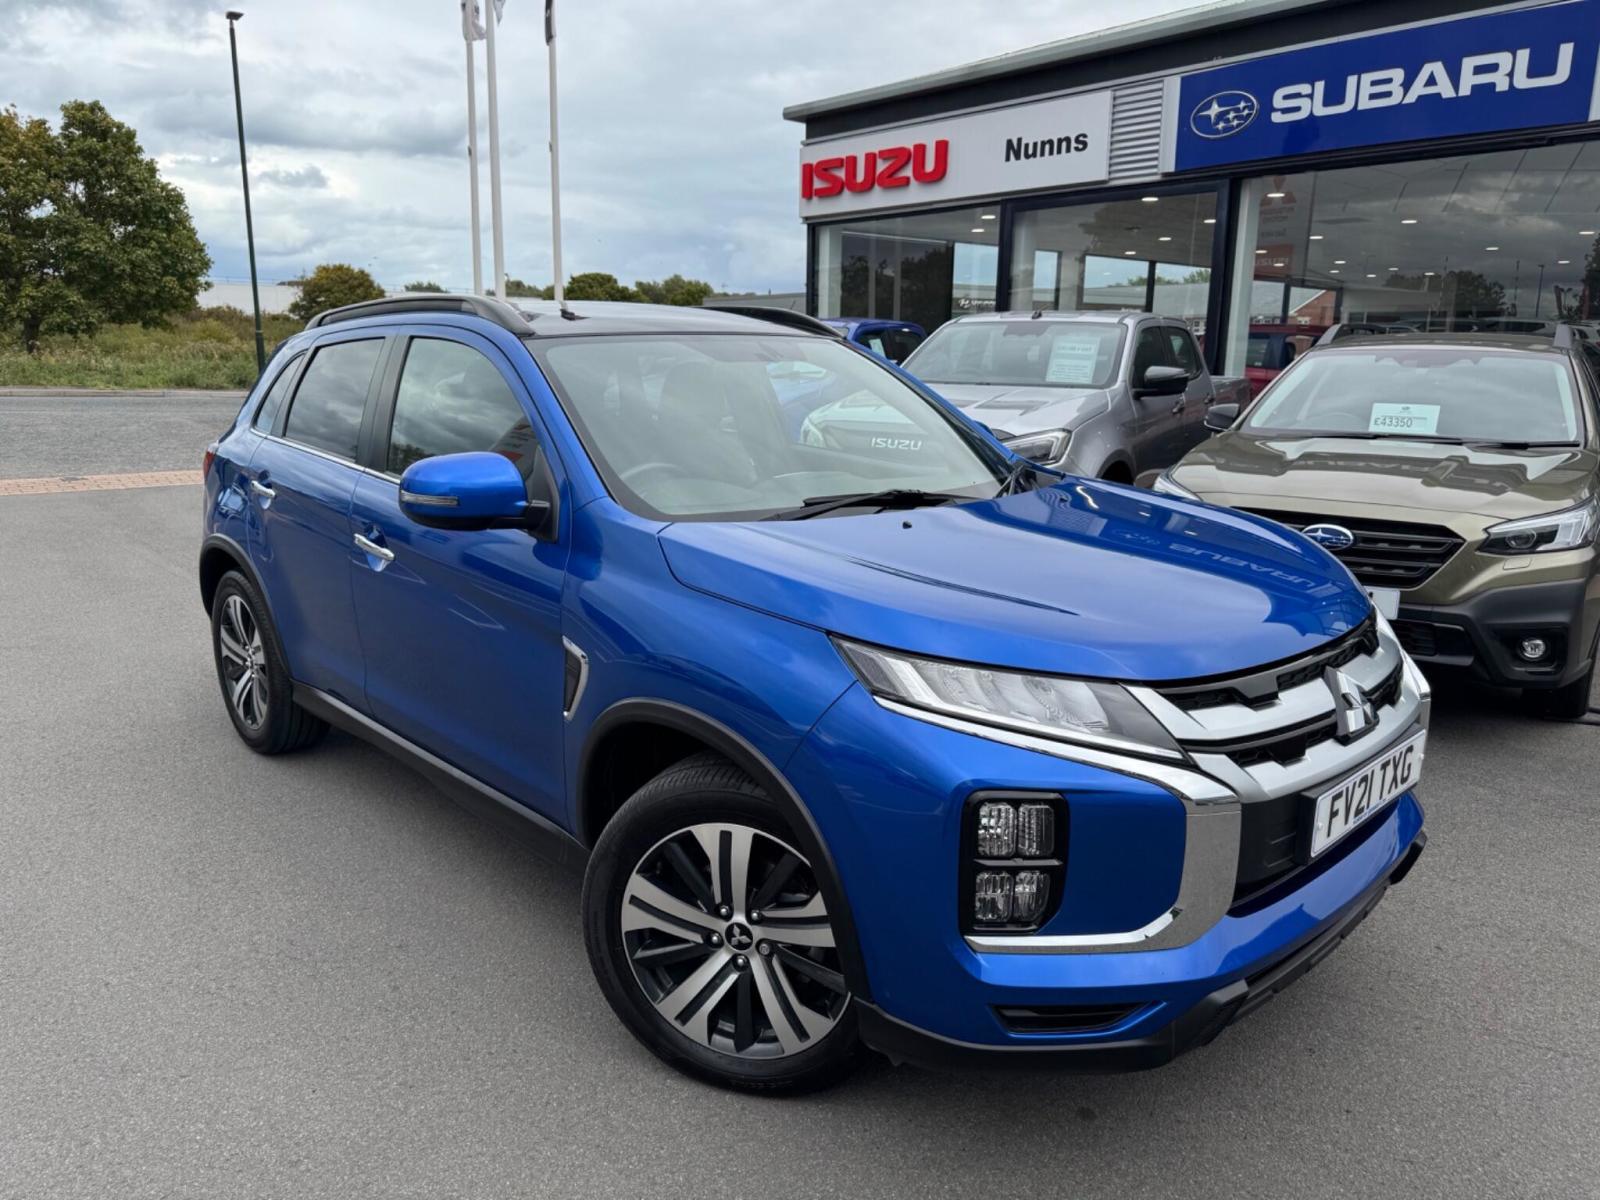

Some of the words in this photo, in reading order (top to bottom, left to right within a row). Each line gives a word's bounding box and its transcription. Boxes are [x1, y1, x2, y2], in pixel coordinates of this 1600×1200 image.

[1270, 42, 1575, 124] SUBARU
[801, 139, 950, 200] ISUZU
[1004, 132, 1089, 162] Nunns
[871, 436, 923, 451] ISUZU
[1326, 769, 1375, 838] FV21
[1379, 744, 1414, 801] TXG
